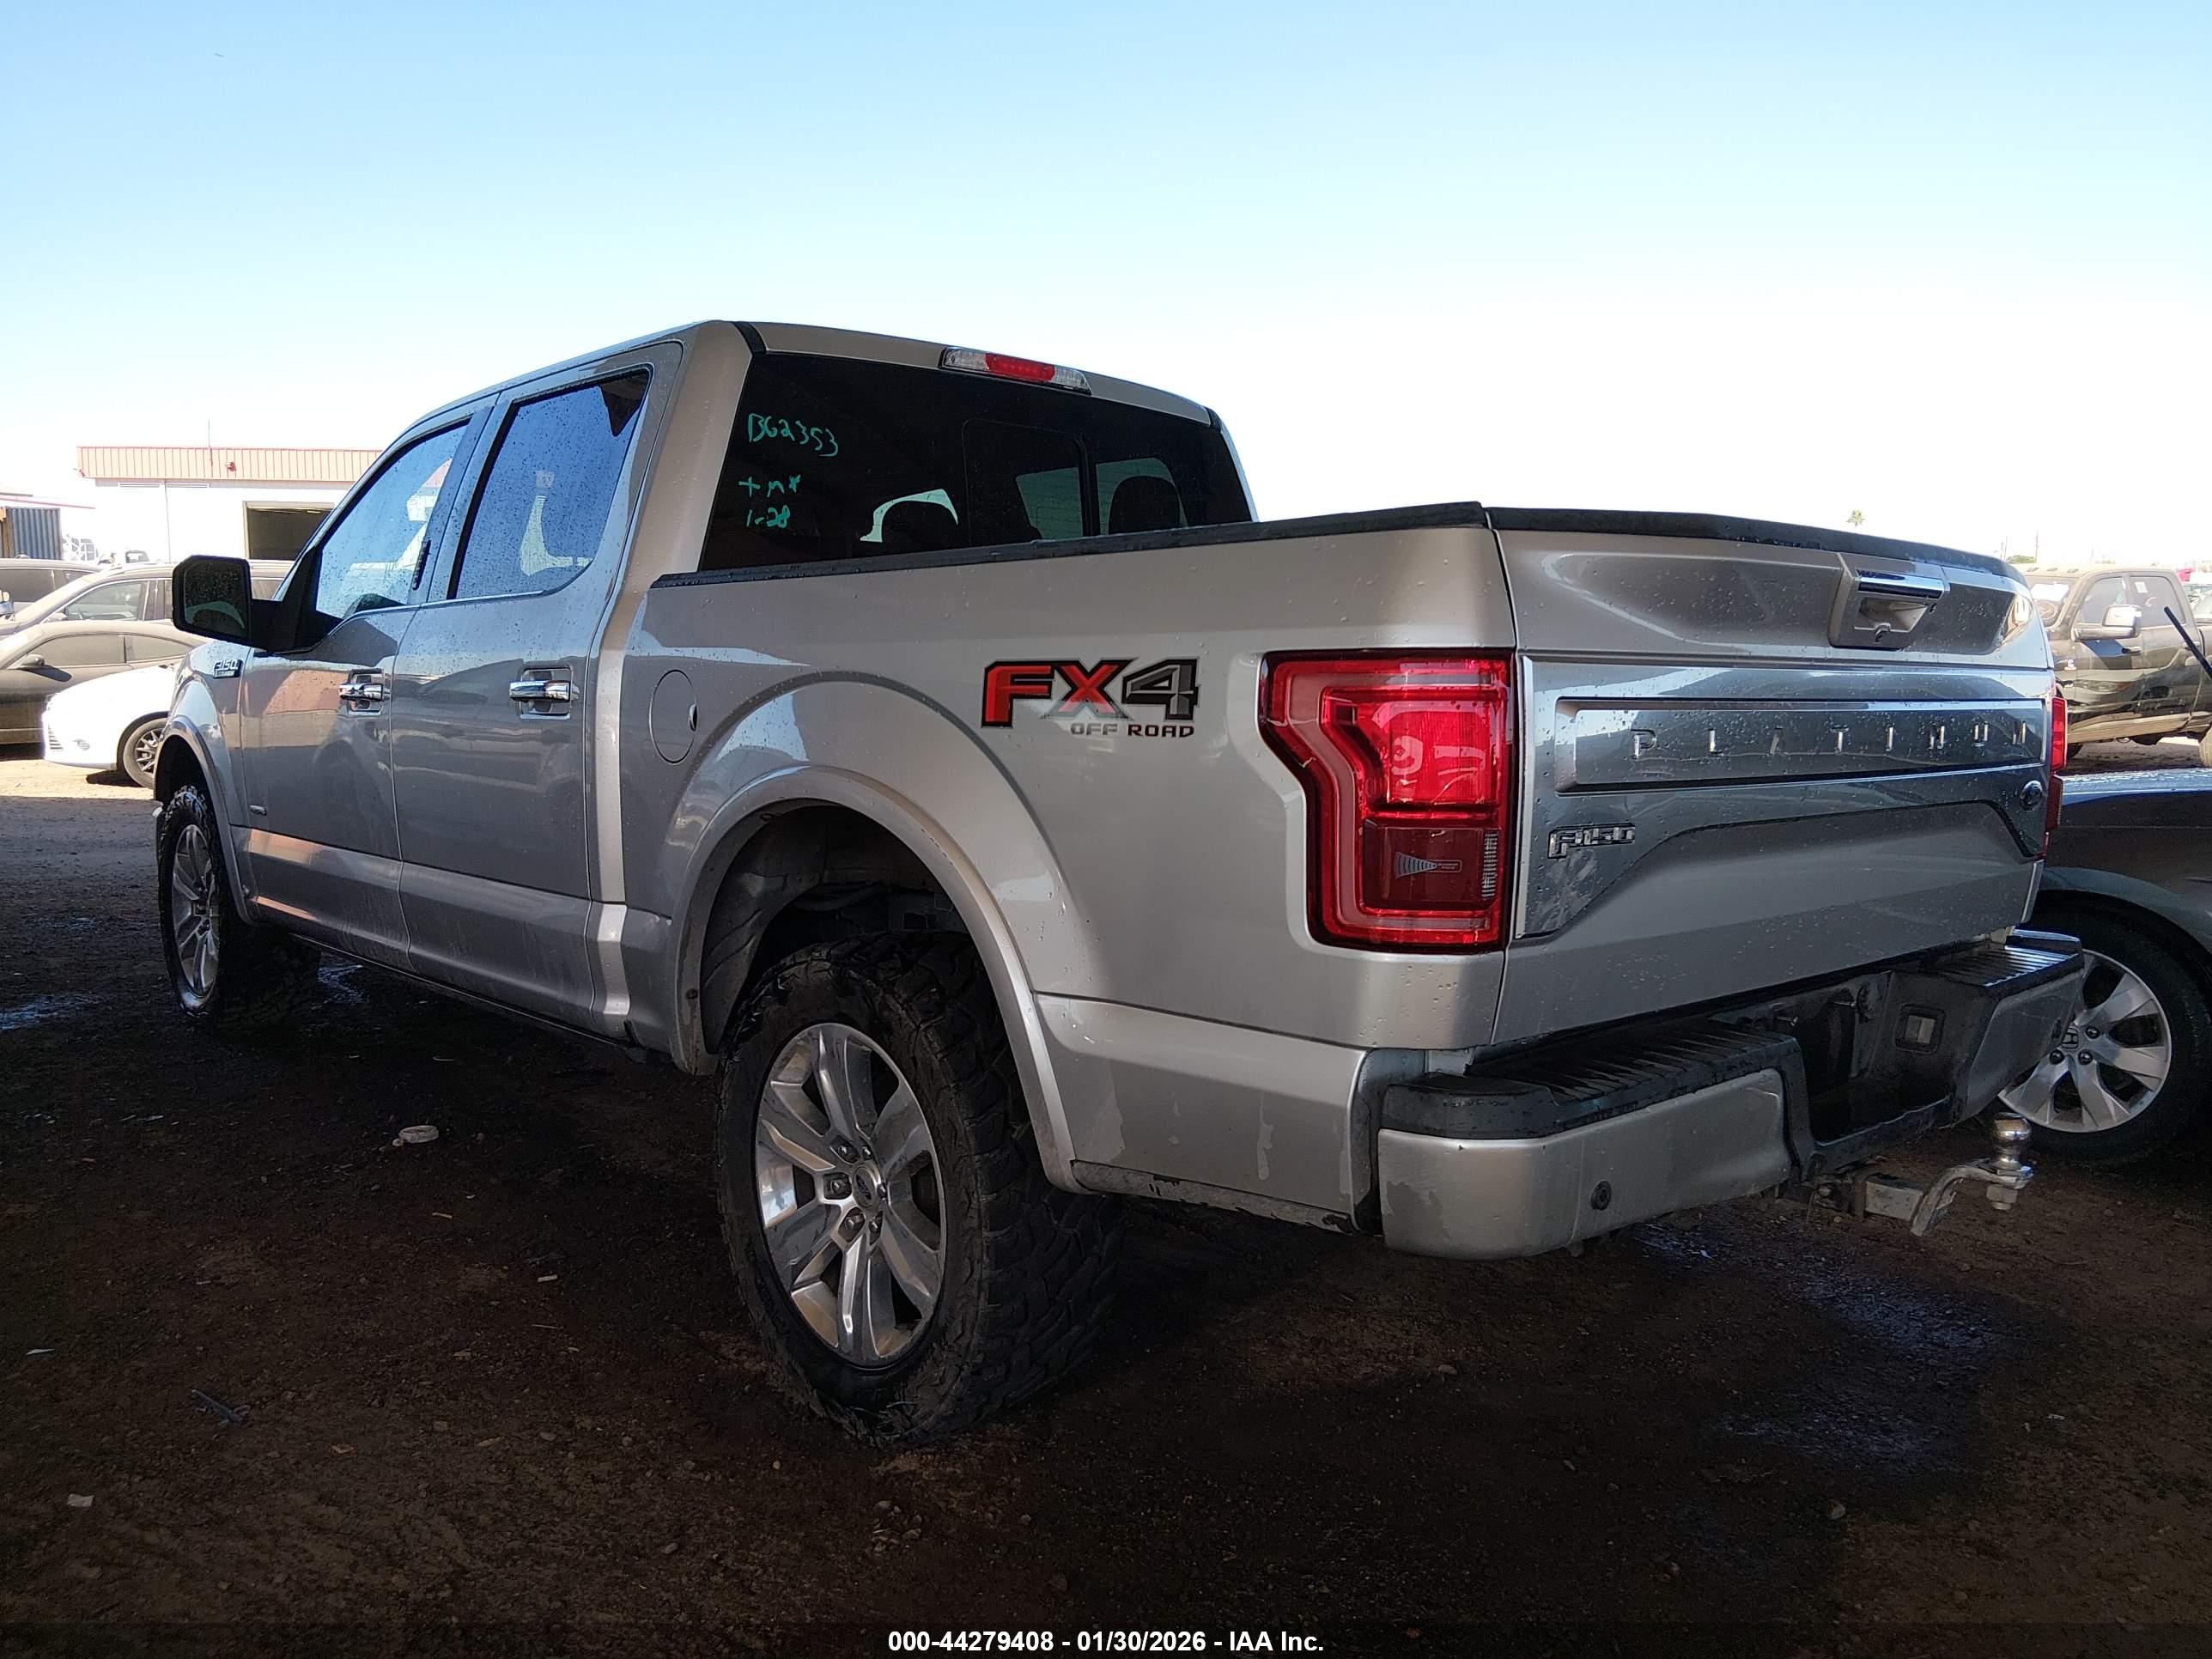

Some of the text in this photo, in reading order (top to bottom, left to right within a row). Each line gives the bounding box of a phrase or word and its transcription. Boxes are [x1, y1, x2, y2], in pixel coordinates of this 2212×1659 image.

[981, 657, 1200, 729] FX4
[1070, 722, 1195, 738] OFF ROAD
